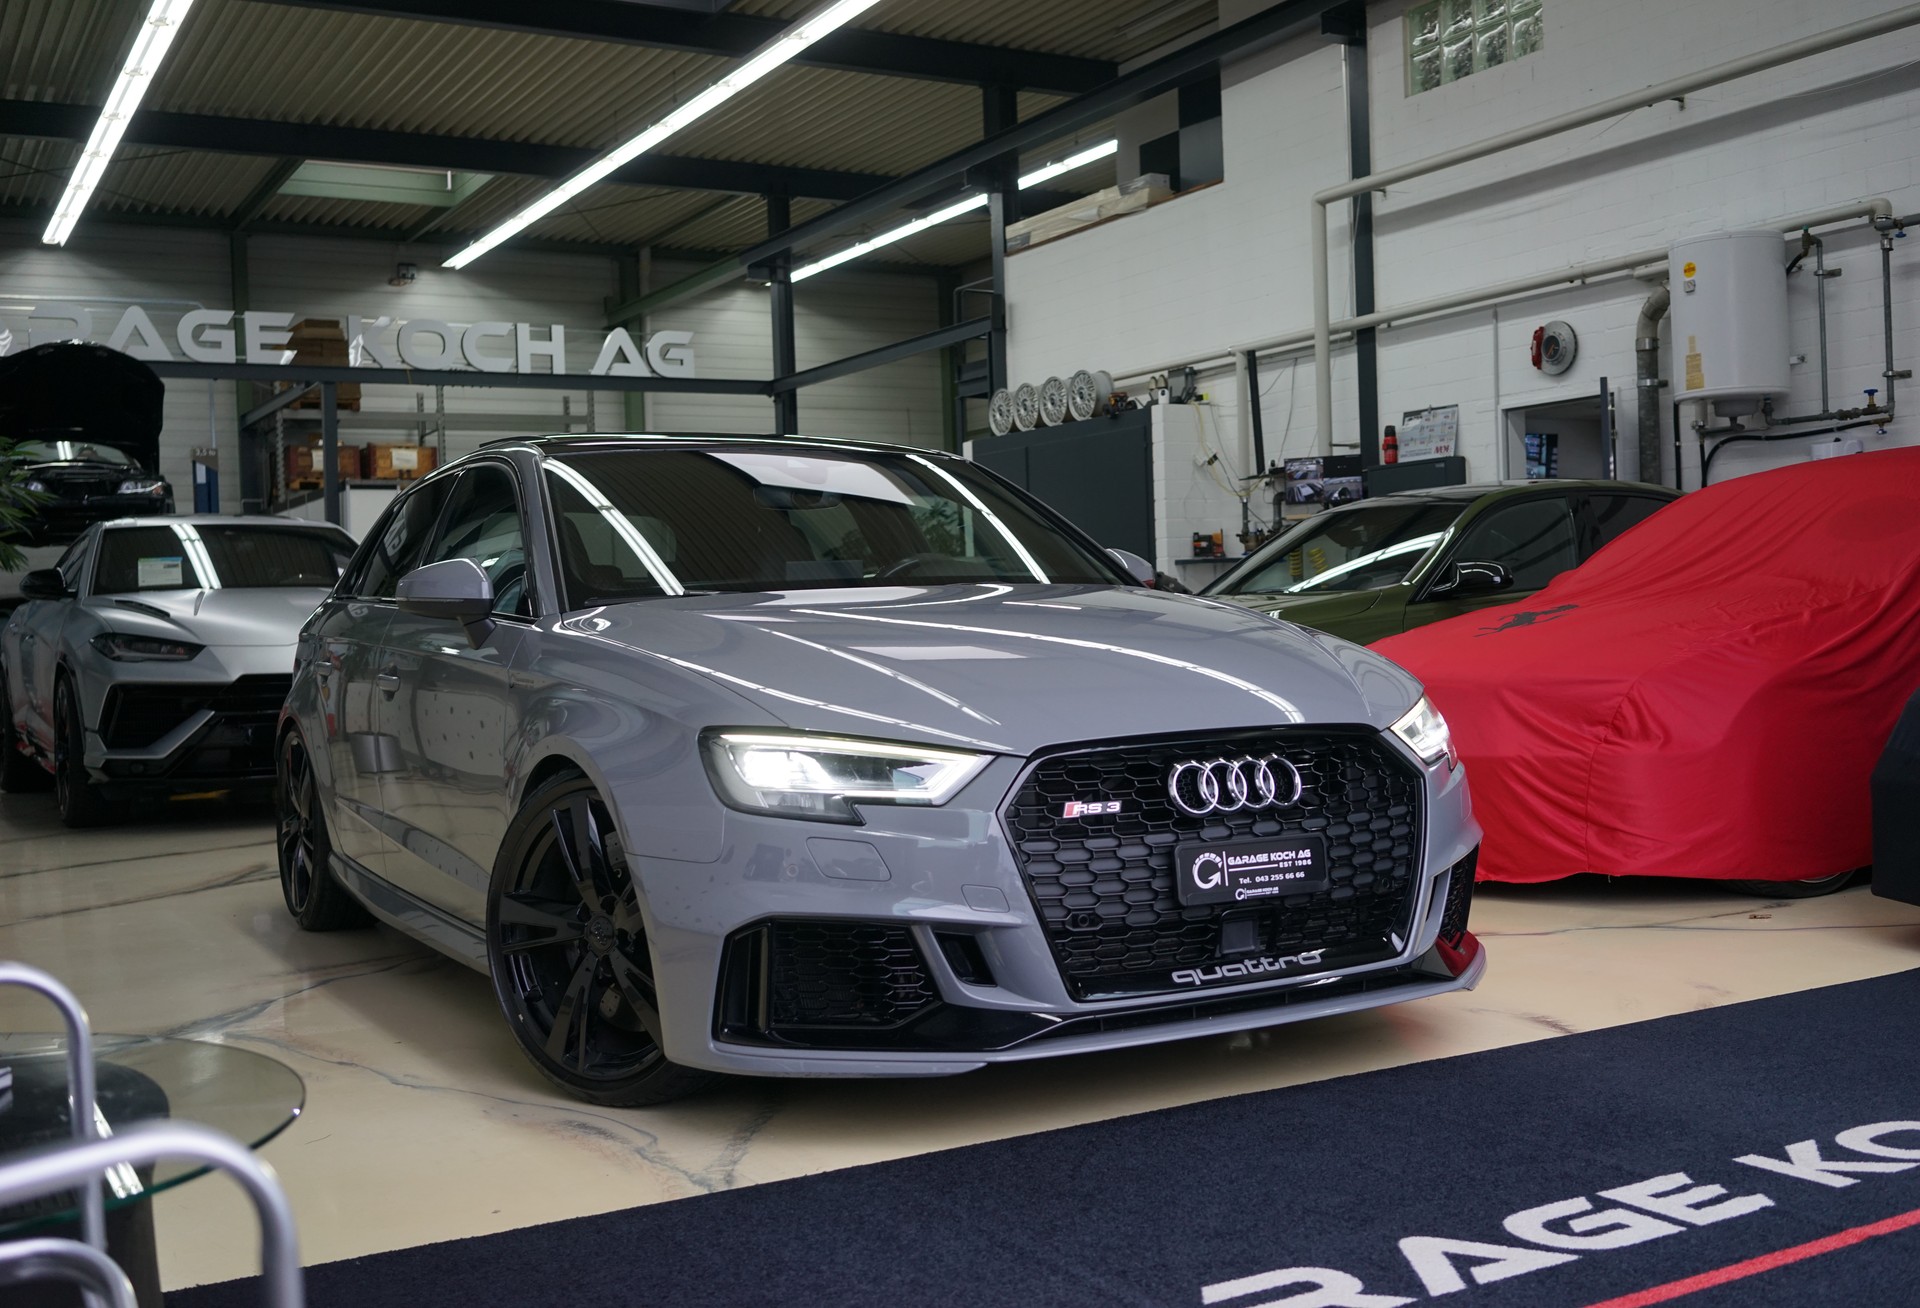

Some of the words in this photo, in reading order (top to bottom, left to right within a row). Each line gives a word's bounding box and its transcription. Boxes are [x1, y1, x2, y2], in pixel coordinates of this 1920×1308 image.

[0, 303, 298, 366] RAGE
[347, 315, 565, 374] KOCH
[590, 326, 695, 379] AG
[1073, 802, 1103, 815] RS
[1106, 801, 1121, 813] 3
[1228, 853, 1269, 866] GARAGE
[1270, 850, 1296, 862] KOCH
[1297, 848, 1312, 859] AG
[1295, 859, 1312, 867] 1986
[1239, 876, 1252, 885] Tel.
[1255, 875, 1269, 883] 043
[1270, 873, 1284, 881] 255
[1285, 872, 1295, 880] 66
[1295, 871, 1305, 879] 66
[1171, 951, 1323, 986] quattro
